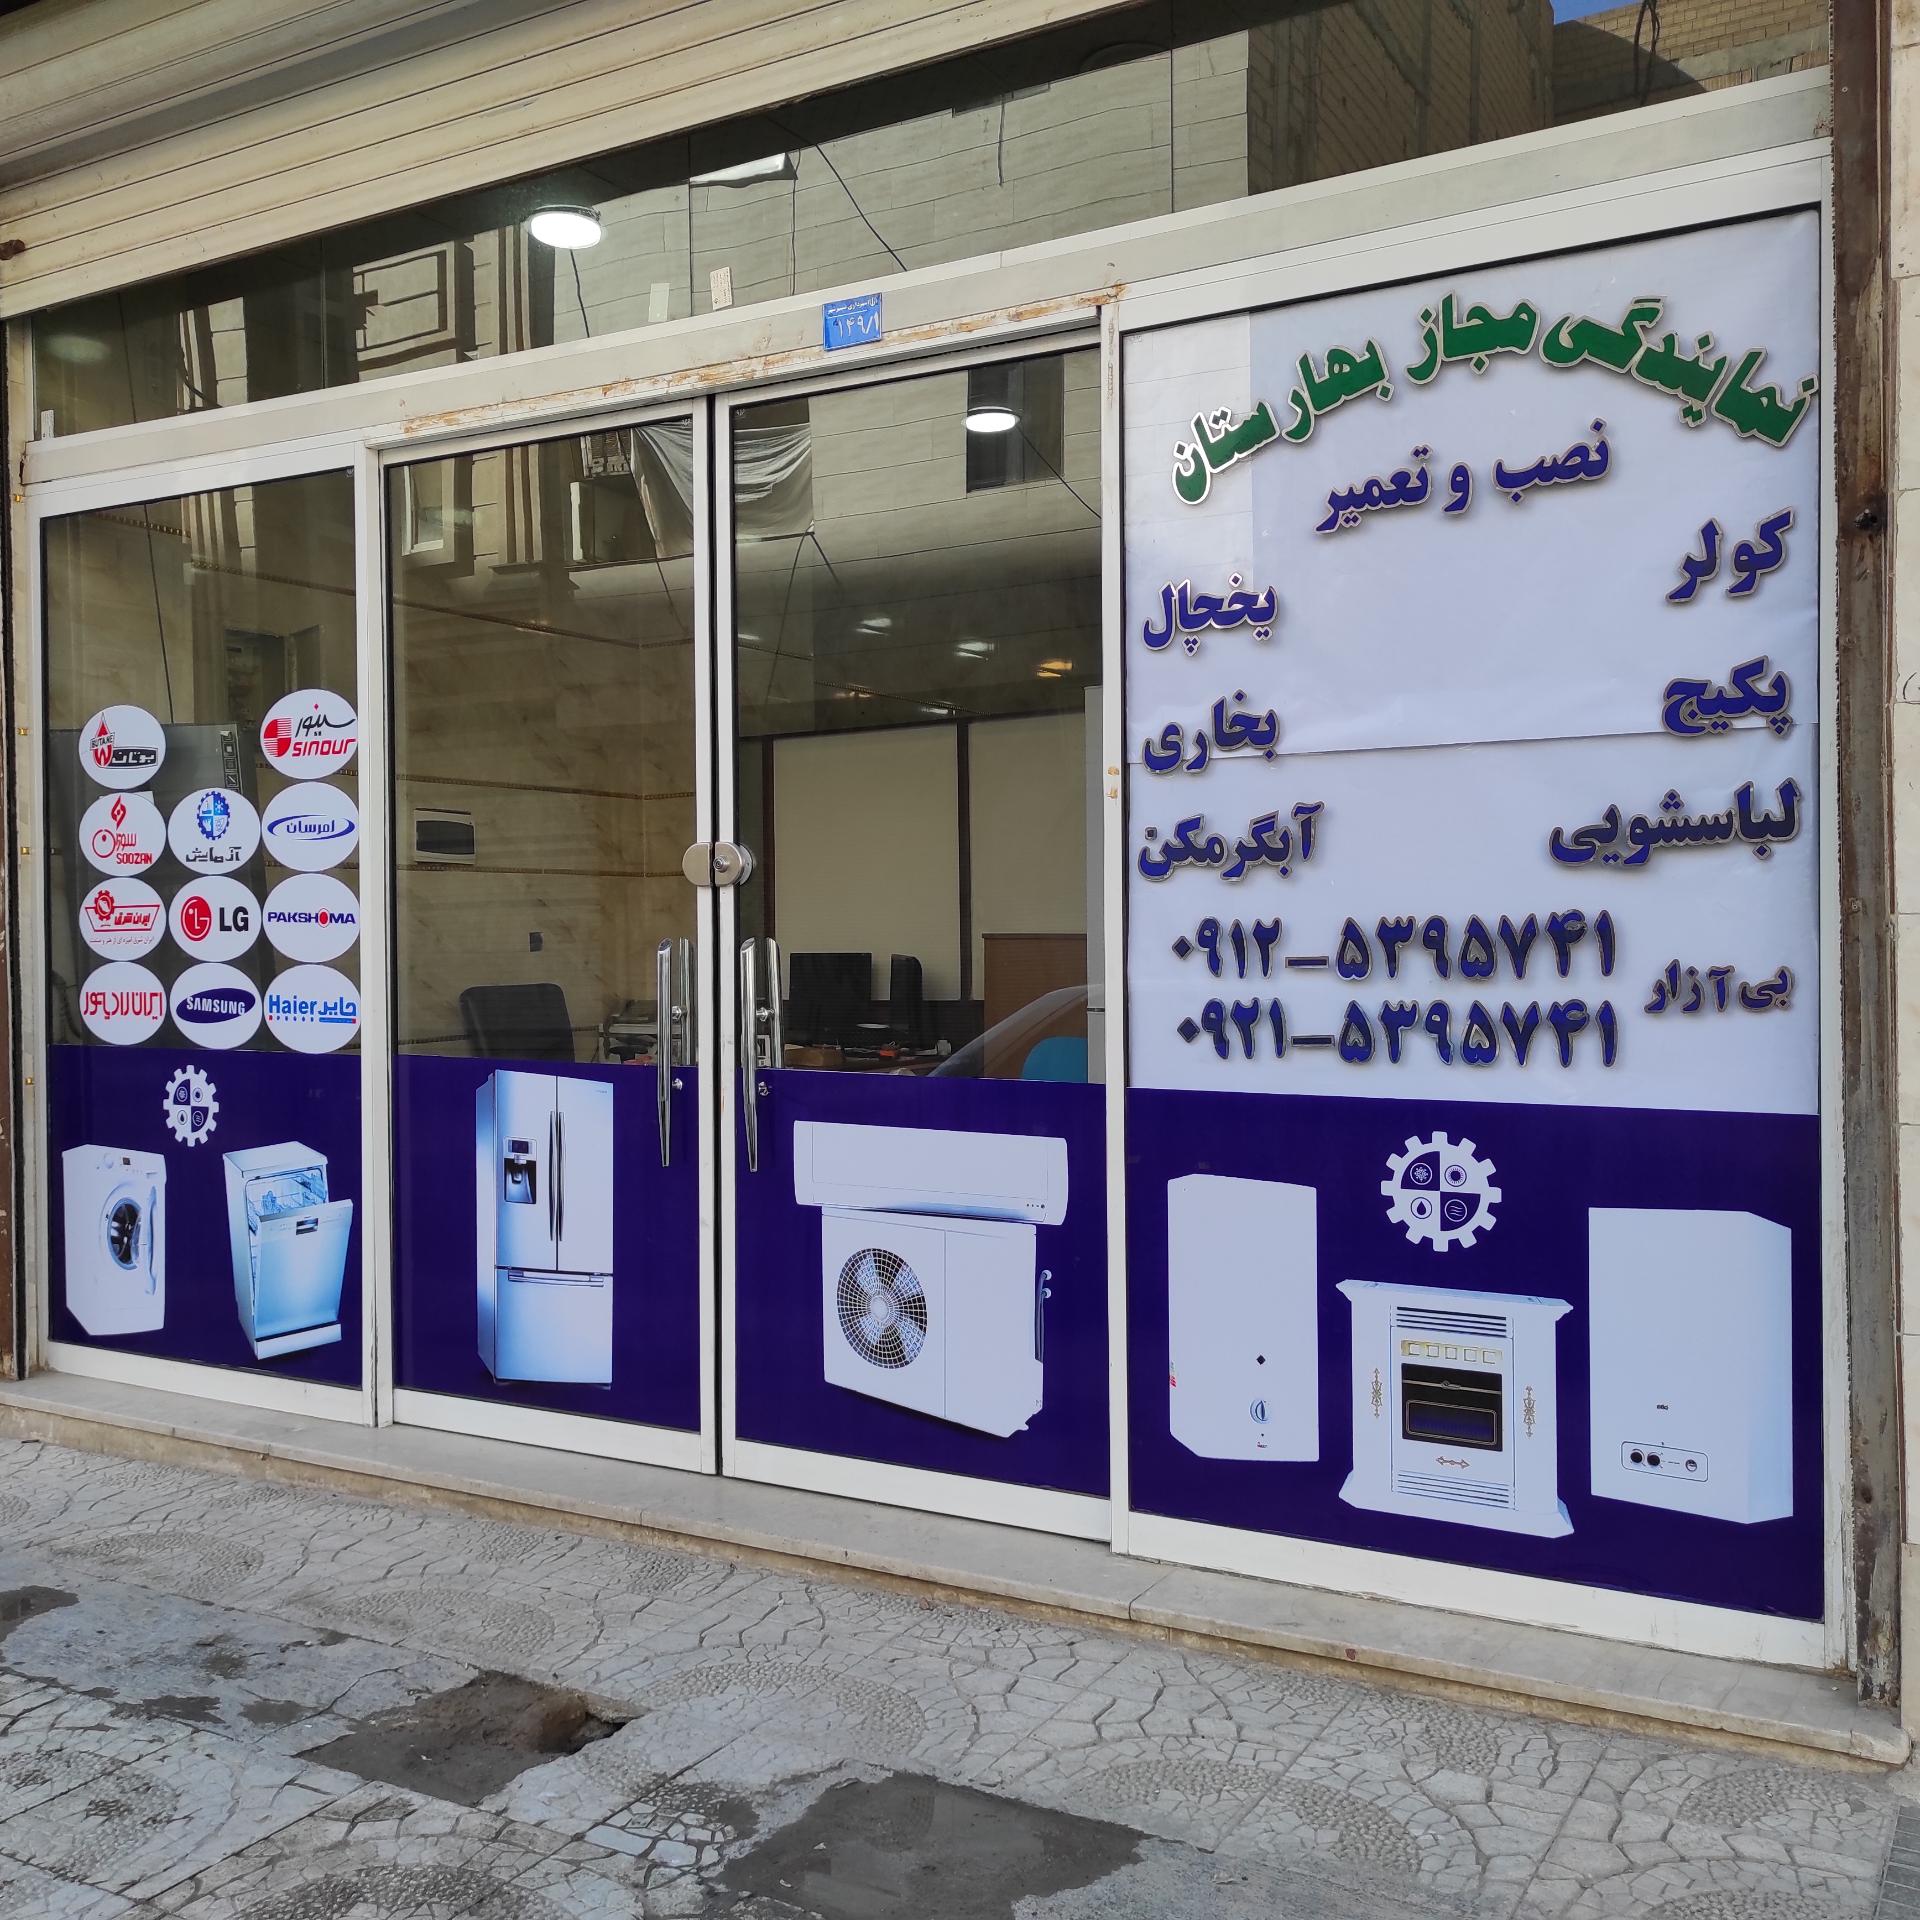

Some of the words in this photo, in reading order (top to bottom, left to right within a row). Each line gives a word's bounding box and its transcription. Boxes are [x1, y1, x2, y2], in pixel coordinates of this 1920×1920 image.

[1406, 290, 1541, 384] مجاز
[1542, 296, 1818, 448] نمایندگی
[1171, 337, 1394, 504] بهارستان
[1491, 416, 1611, 505] نصب
[1315, 445, 1433, 533] تعمیر
[1442, 460, 1472, 513] و
[1665, 508, 1794, 604] کولر
[1142, 571, 1279, 657] یخچال
[1142, 690, 1280, 774] بخاری
[1661, 654, 1793, 737] پکیج
[1138, 802, 1324, 881] آبگرمکن
[1548, 777, 1801, 867] لباسشویی
[219, 906, 249, 932] LG
[267, 908, 356, 928] PAKSHOMA
[186, 995, 246, 1016] SAMSUNG
[268, 994, 318, 1015] Haier
[1643, 959, 1735, 1013] آزار
[1739, 965, 1794, 1011] بی
